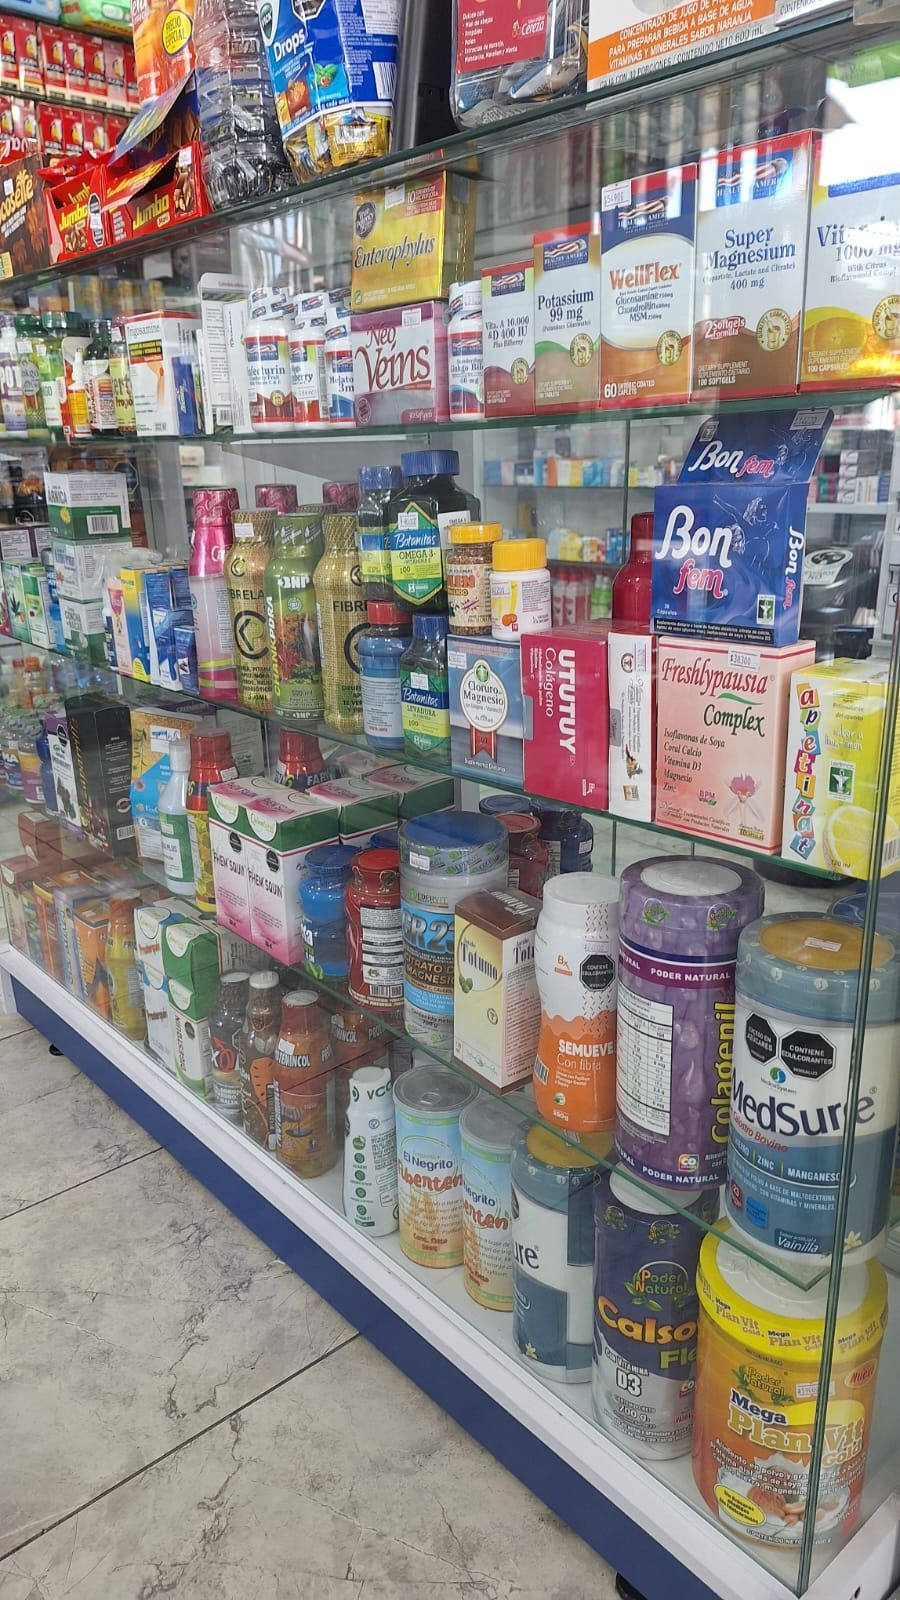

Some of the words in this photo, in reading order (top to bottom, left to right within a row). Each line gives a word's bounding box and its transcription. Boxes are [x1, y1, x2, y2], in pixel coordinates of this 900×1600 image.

[521, 20, 545, 36] Cereza
[609, 45, 626, 58] PARA
[627, 33, 661, 51] PREPARAR
[663, 22, 689, 38] BEBIDA
[697, 11, 718, 25] BASE
[719, 6, 730, 18] DE
[619, 15, 667, 41] CONCENTRADO
[668, 12, 678, 21] DE
[680, 6, 698, 18] JUGO
[273, 29, 305, 62] Drops
[609, 52, 643, 71] VITAMINAS
[650, 36, 689, 56] MINERALES
[690, 24, 715, 42] SABOR
[717, 12, 752, 33] NARANJA
[407, 191, 416, 204] 10
[132, 193, 169, 230] Jumbo
[725, 227, 774, 249] Super
[354, 232, 436, 270] Enterophylus
[706, 243, 796, 271] Magnesium
[609, 262, 680, 290] WellFlex
[735, 267, 756, 277] Lactate
[758, 265, 769, 273] and
[771, 262, 795, 272] Citrate)
[730, 278, 748, 290] 400
[751, 278, 765, 288] mg
[538, 289, 594, 310] Potassium
[550, 308, 563, 322] 99
[566, 306, 583, 321] mg
[629, 312, 648, 322] MSM
[501, 327, 515, 338] 400
[518, 326, 528, 336] IU
[704, 322, 714, 339] 2
[713, 317, 746, 331] Softgels
[713, 327, 739, 338] Formula
[354, 345, 431, 392] Veins
[604, 384, 617, 398] 60
[708, 376, 736, 386] SOFTGELS
[688, 440, 744, 473] Bon
[735, 454, 775, 478] fem
[394, 532, 436, 549] Botanitas
[655, 505, 733, 568] Bon
[399, 551, 427, 561] OMEGA
[785, 525, 805, 576] Bon
[672, 558, 724, 599] fem
[782, 576, 797, 610] fem
[468, 681, 499, 694] Cloruro
[543, 647, 556, 717] Colágeno
[662, 657, 768, 697] Freshlypausia
[402, 687, 438, 708] Botanitas
[463, 690, 504, 706] Magnesio
[558, 649, 576, 755] UTUTUY
[703, 703, 765, 738] Complex
[663, 728, 698, 744] Isoflavonas
[709, 736, 725, 749] Soya
[663, 742, 681, 753] Coral
[682, 745, 702, 757] Calcio
[664, 755, 690, 769] Vitamina
[691, 761, 702, 771] D3
[663, 769, 692, 783] Magnesio
[699, 790, 715, 799] BPM
[461, 941, 498, 981] Totumo
[650, 966, 682, 981] PODER
[684, 972, 731, 982] NATURAL
[559, 1038, 614, 1058] SEMUEVE
[781, 1050, 833, 1065] EDULCORANTES
[789, 1044, 825, 1056] CONTIENE
[557, 1053, 577, 1068] Con
[580, 1057, 601, 1070] fibra
[711, 1002, 736, 1145] Colagenil
[754, 1131, 788, 1152] Bovino
[403, 1151, 411, 1163] El
[412, 1157, 453, 1172] Negrito
[757, 1155, 775, 1170] ZINC
[642, 1165, 673, 1183] PODER
[675, 1173, 719, 1184] NATURAL
[778, 1236, 819, 1253] Vainilla
[641, 1269, 682, 1283] Poder
[635, 1279, 688, 1296] Natural
[715, 1304, 740, 1325] Plan
[741, 1316, 759, 1330] Vit
[768, 1330, 790, 1338] Mega
[768, 1336, 801, 1347] Plan
[803, 1335, 822, 1346] Vit
[617, 1354, 649, 1377] VITAMINA
[616, 1369, 642, 1397] D3
[743, 1374, 786, 1397] Natural
[748, 1367, 781, 1388] Poder
[730, 1389, 787, 1426] Mega
[728, 1403, 811, 1454] Plan
[823, 1415, 865, 1453] Vit
[822, 1439, 863, 1468] Gold
[760, 1467, 784, 1479] polvo
[770, 1475, 781, 1485] de
